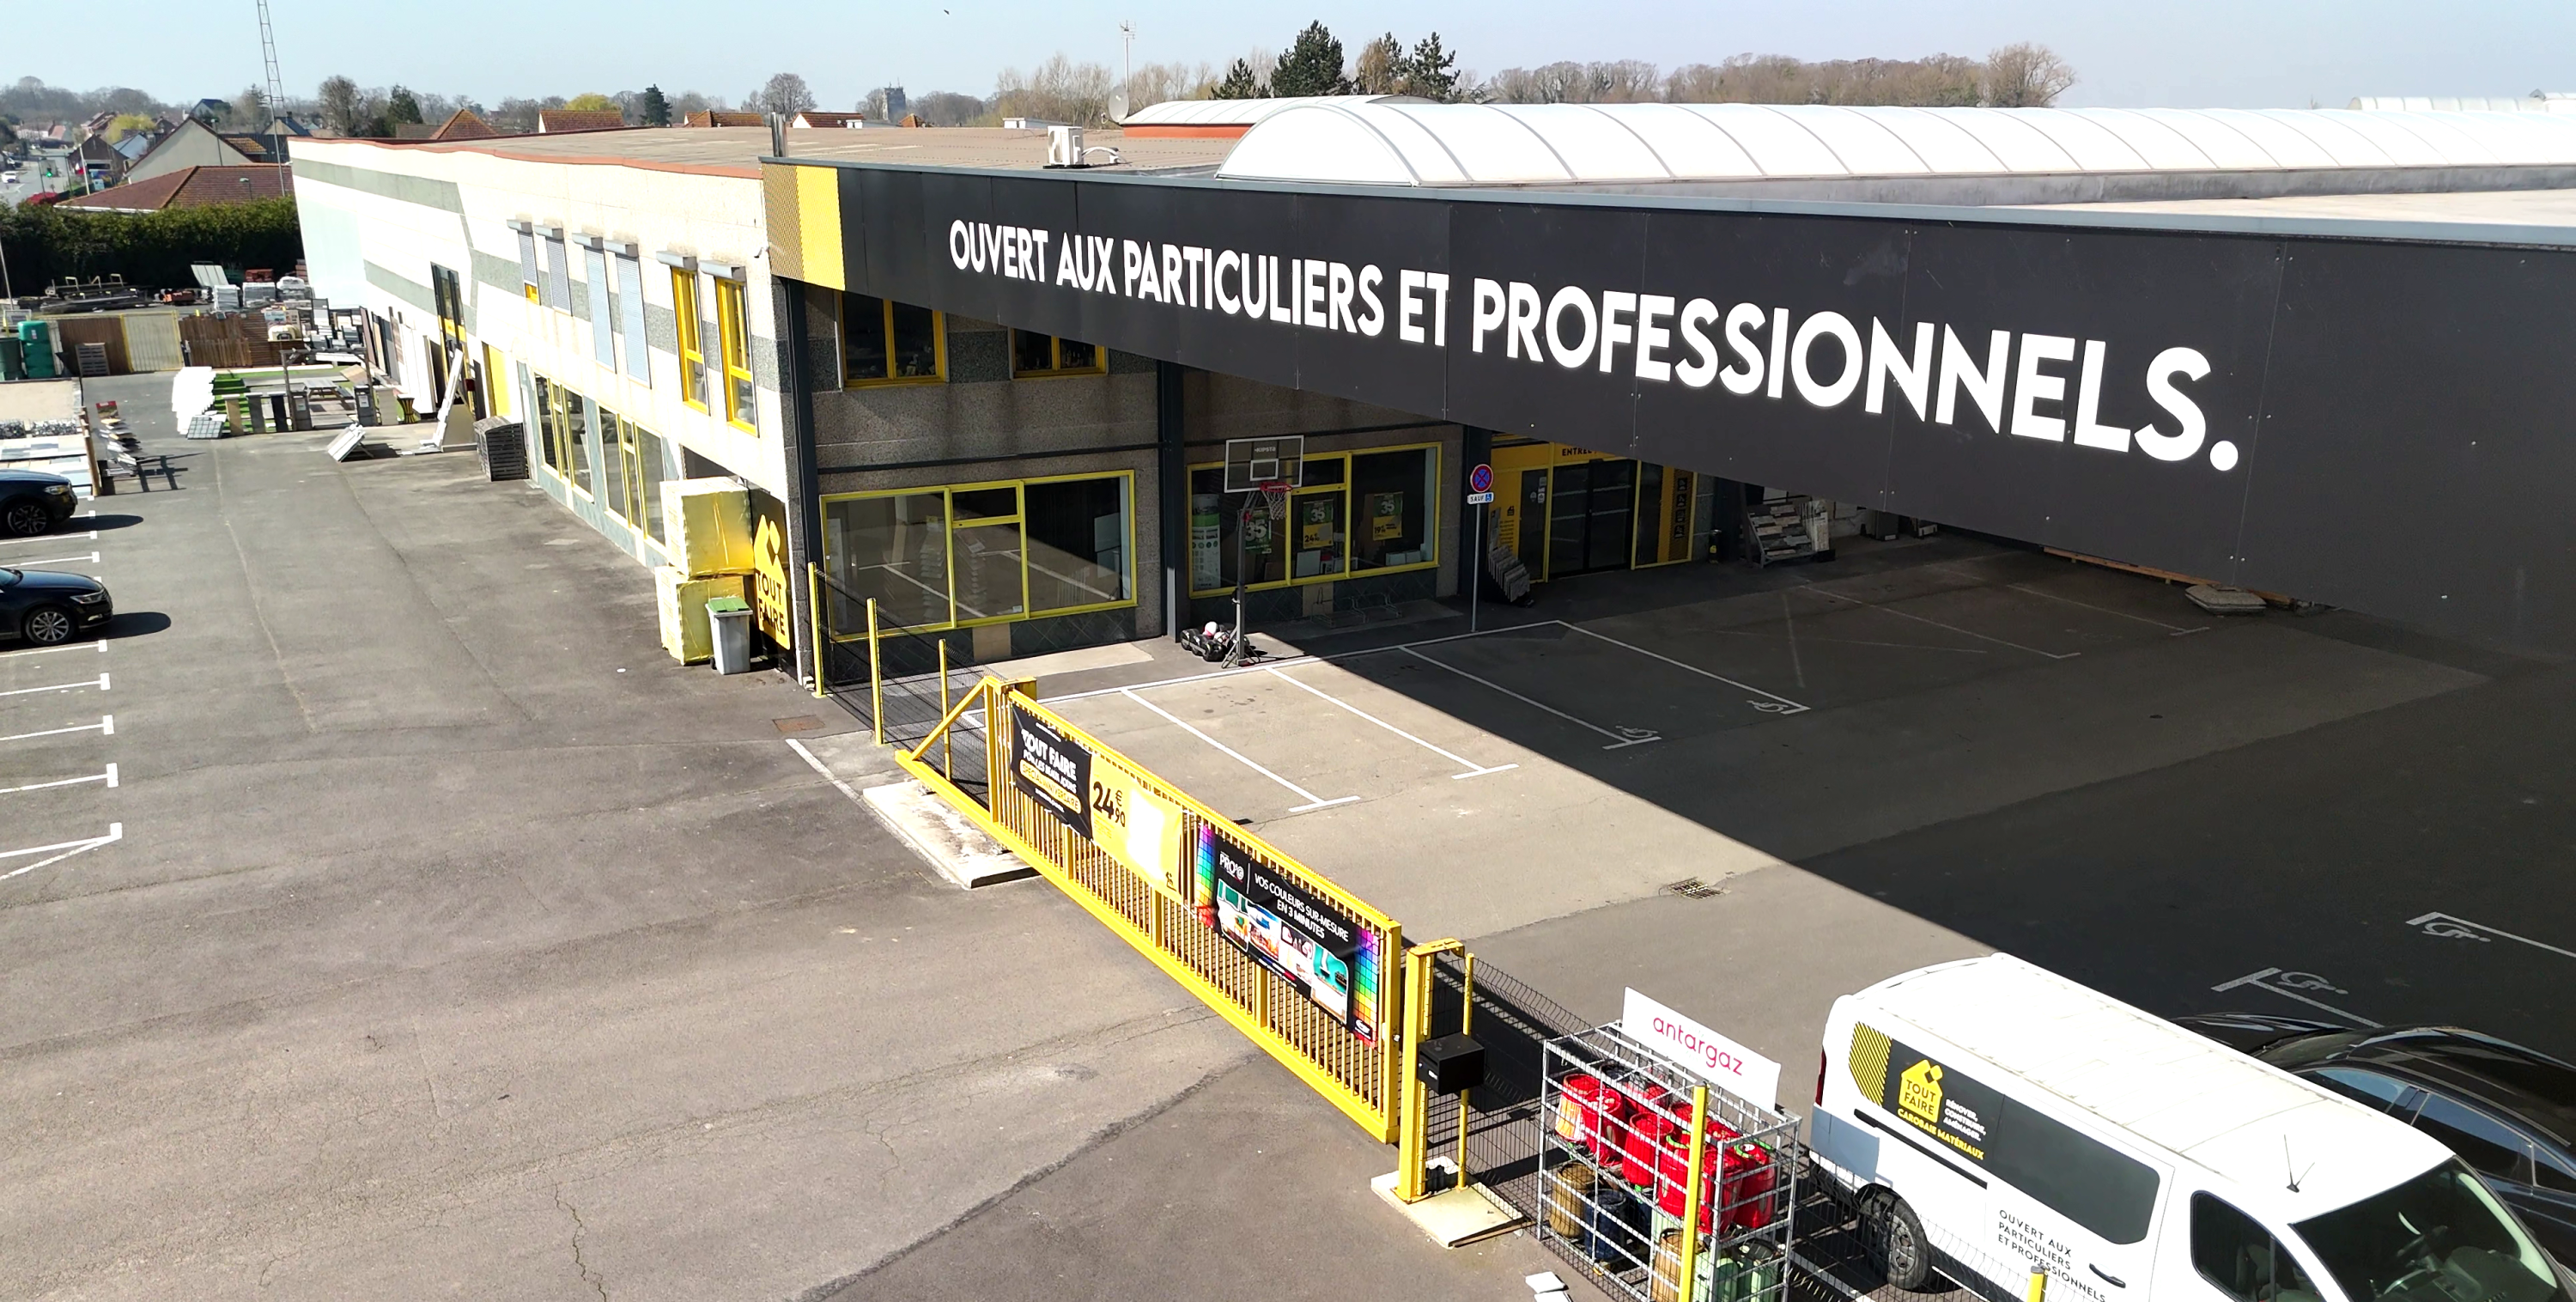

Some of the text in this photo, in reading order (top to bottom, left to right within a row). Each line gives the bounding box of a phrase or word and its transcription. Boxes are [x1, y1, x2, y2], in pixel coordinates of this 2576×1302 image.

[949, 219, 2239, 472] OUVERT AUX PARTICULIERS ET PROFESSIONNELS.
[1245, 519, 1267, 541] 35
[1311, 507, 1325, 522] 35
[1381, 501, 1395, 514] 35
[756, 568, 781, 605] TOUT
[758, 597, 785, 636] FAIRE
[1021, 729, 1048, 760] TOUT
[1049, 747, 1077, 781] FAIRE
[1093, 781, 1114, 820] 24
[1115, 807, 1126, 828] 90
[1255, 873, 1349, 942] VOS COULEURS SUR-MESURE
[1277, 900, 1325, 940] EN 3 MINUTES
[1653, 1017, 1743, 1076] antargaz
[1904, 1092, 1935, 1116] FAIRE
[1906, 1079, 1936, 1103] TOUT
[1897, 1108, 1984, 1160] CAROBAIE MATÉRIAUX
[1999, 1209, 2072, 1257] OUVERT AUX
[1999, 1221, 2071, 1270] PARTICULIERS
[1998, 1233, 2106, 1302] ET PROFESSIONNELS
